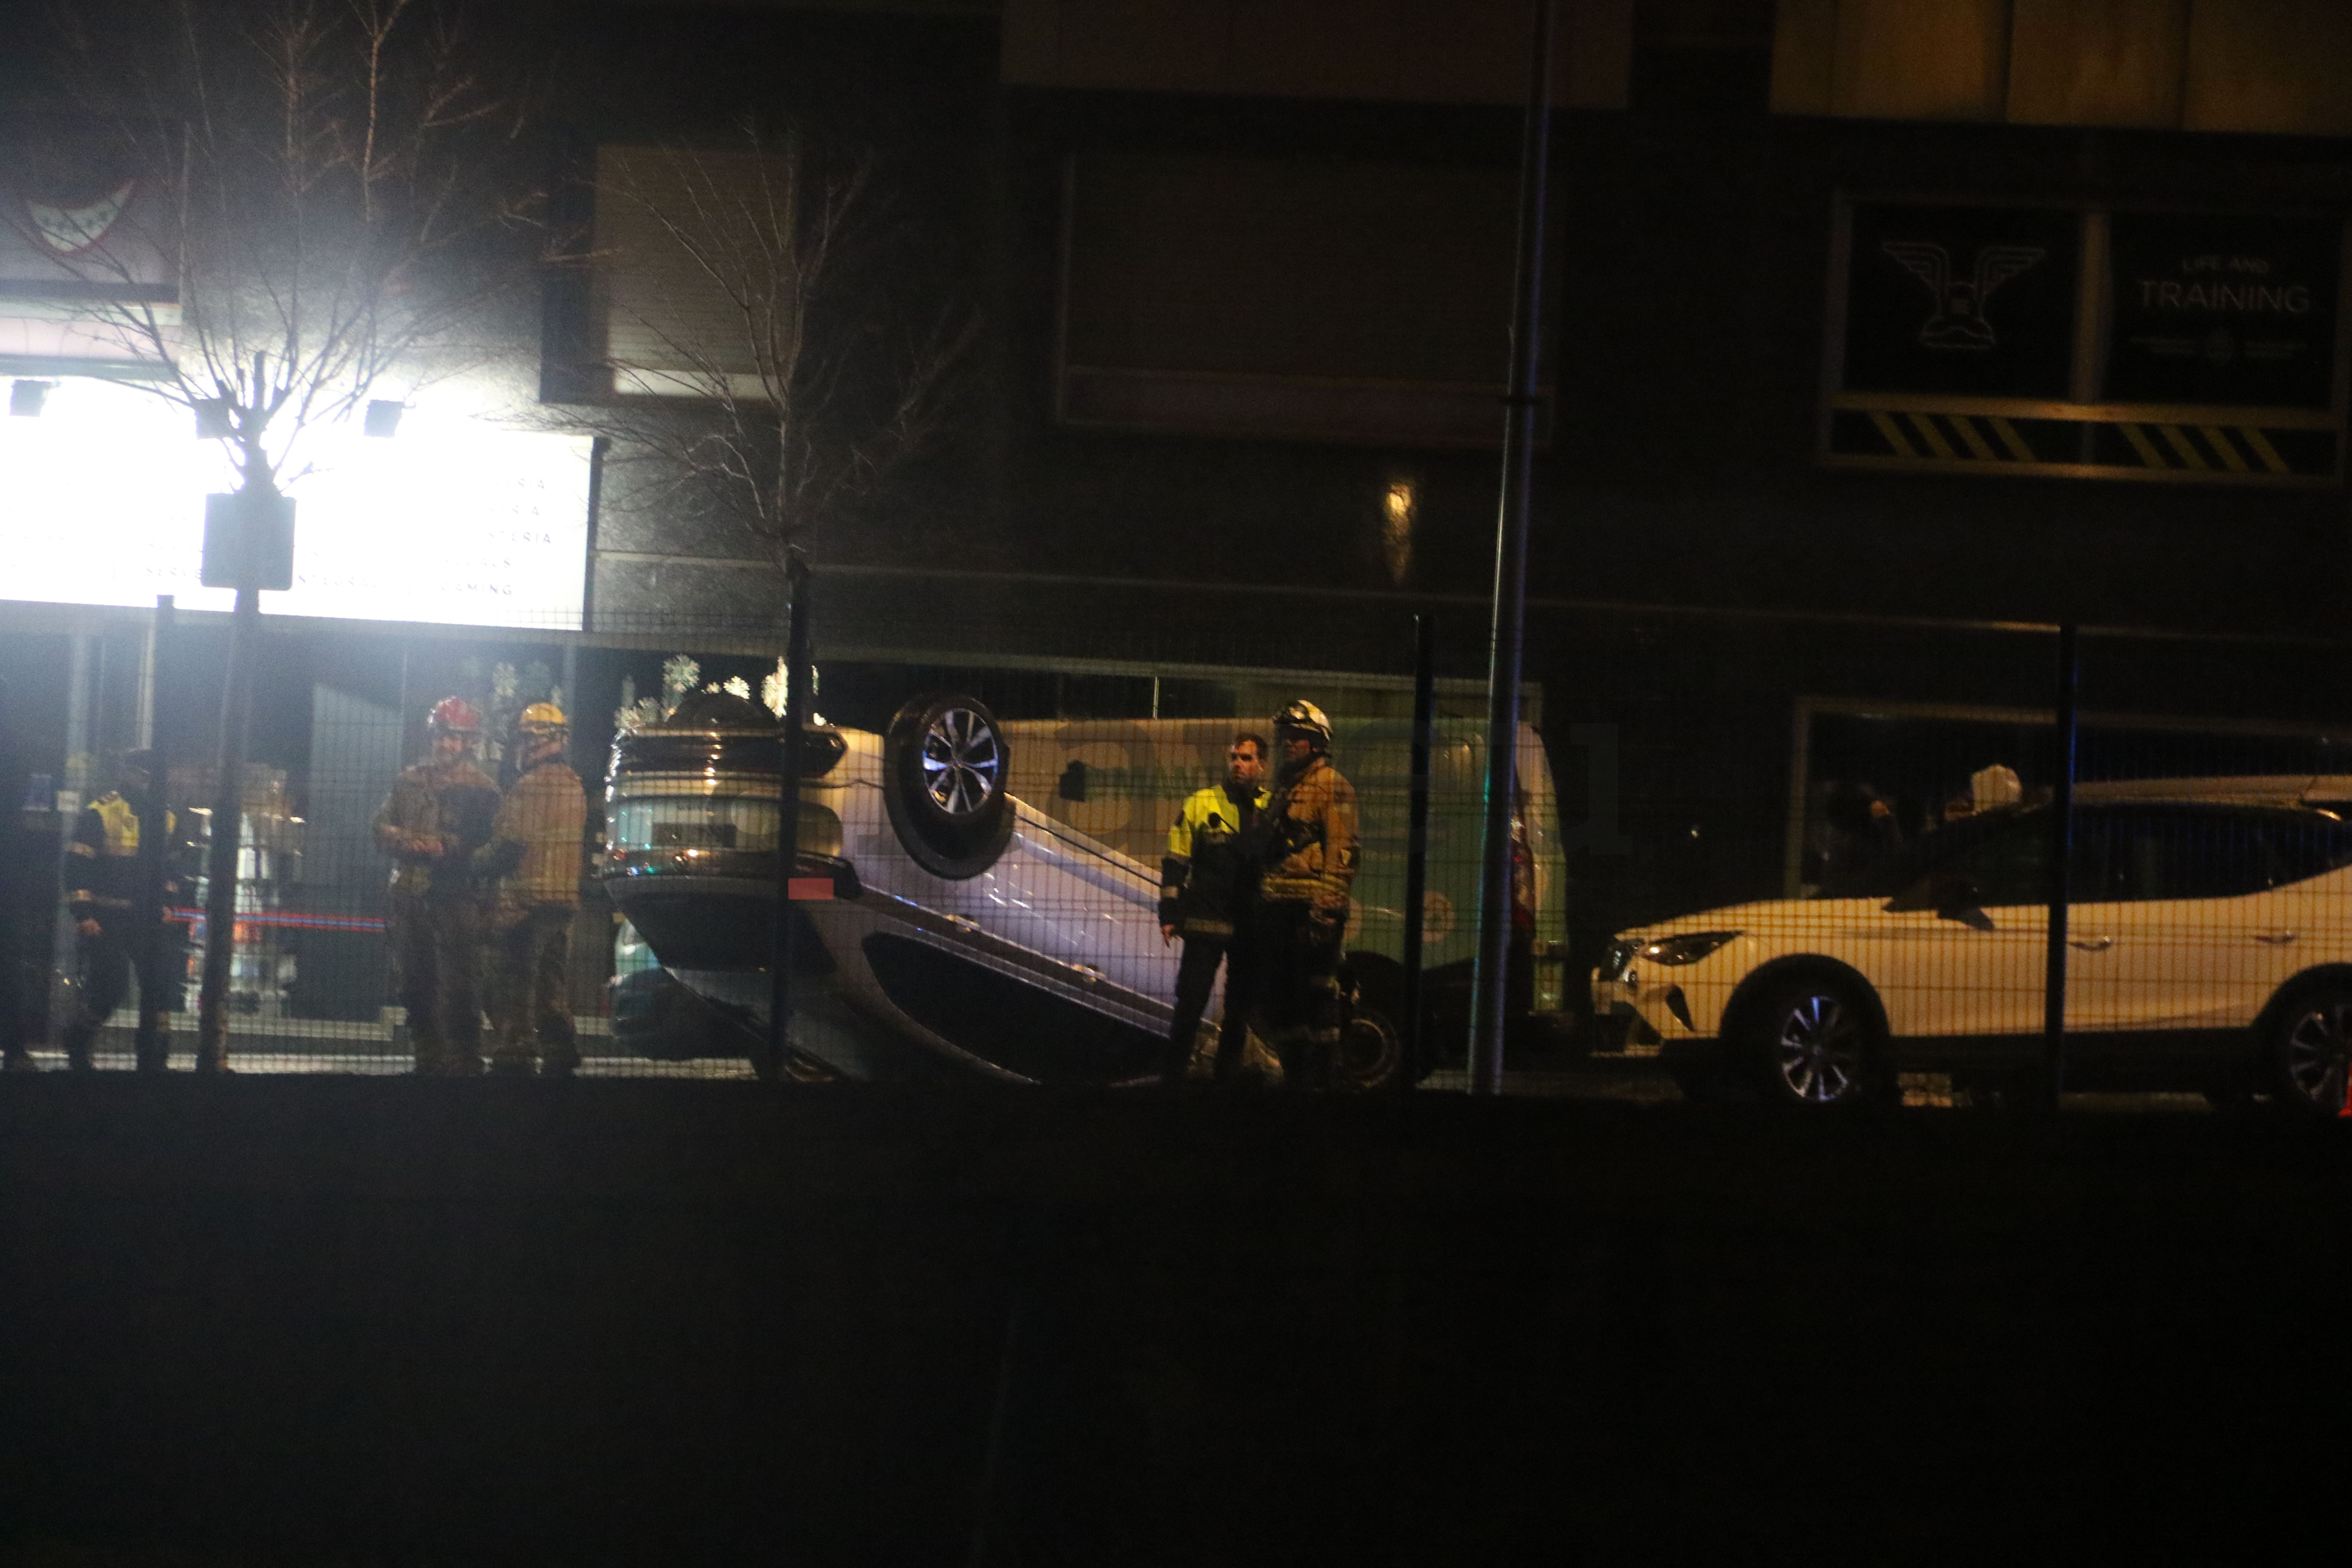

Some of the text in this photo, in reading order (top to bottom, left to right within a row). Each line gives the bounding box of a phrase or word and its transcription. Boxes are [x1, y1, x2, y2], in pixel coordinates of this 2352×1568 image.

[2230, 256, 2271, 275] AND
[2137, 279, 2310, 314] TRAINING
[441, 581, 513, 597] GAMING
